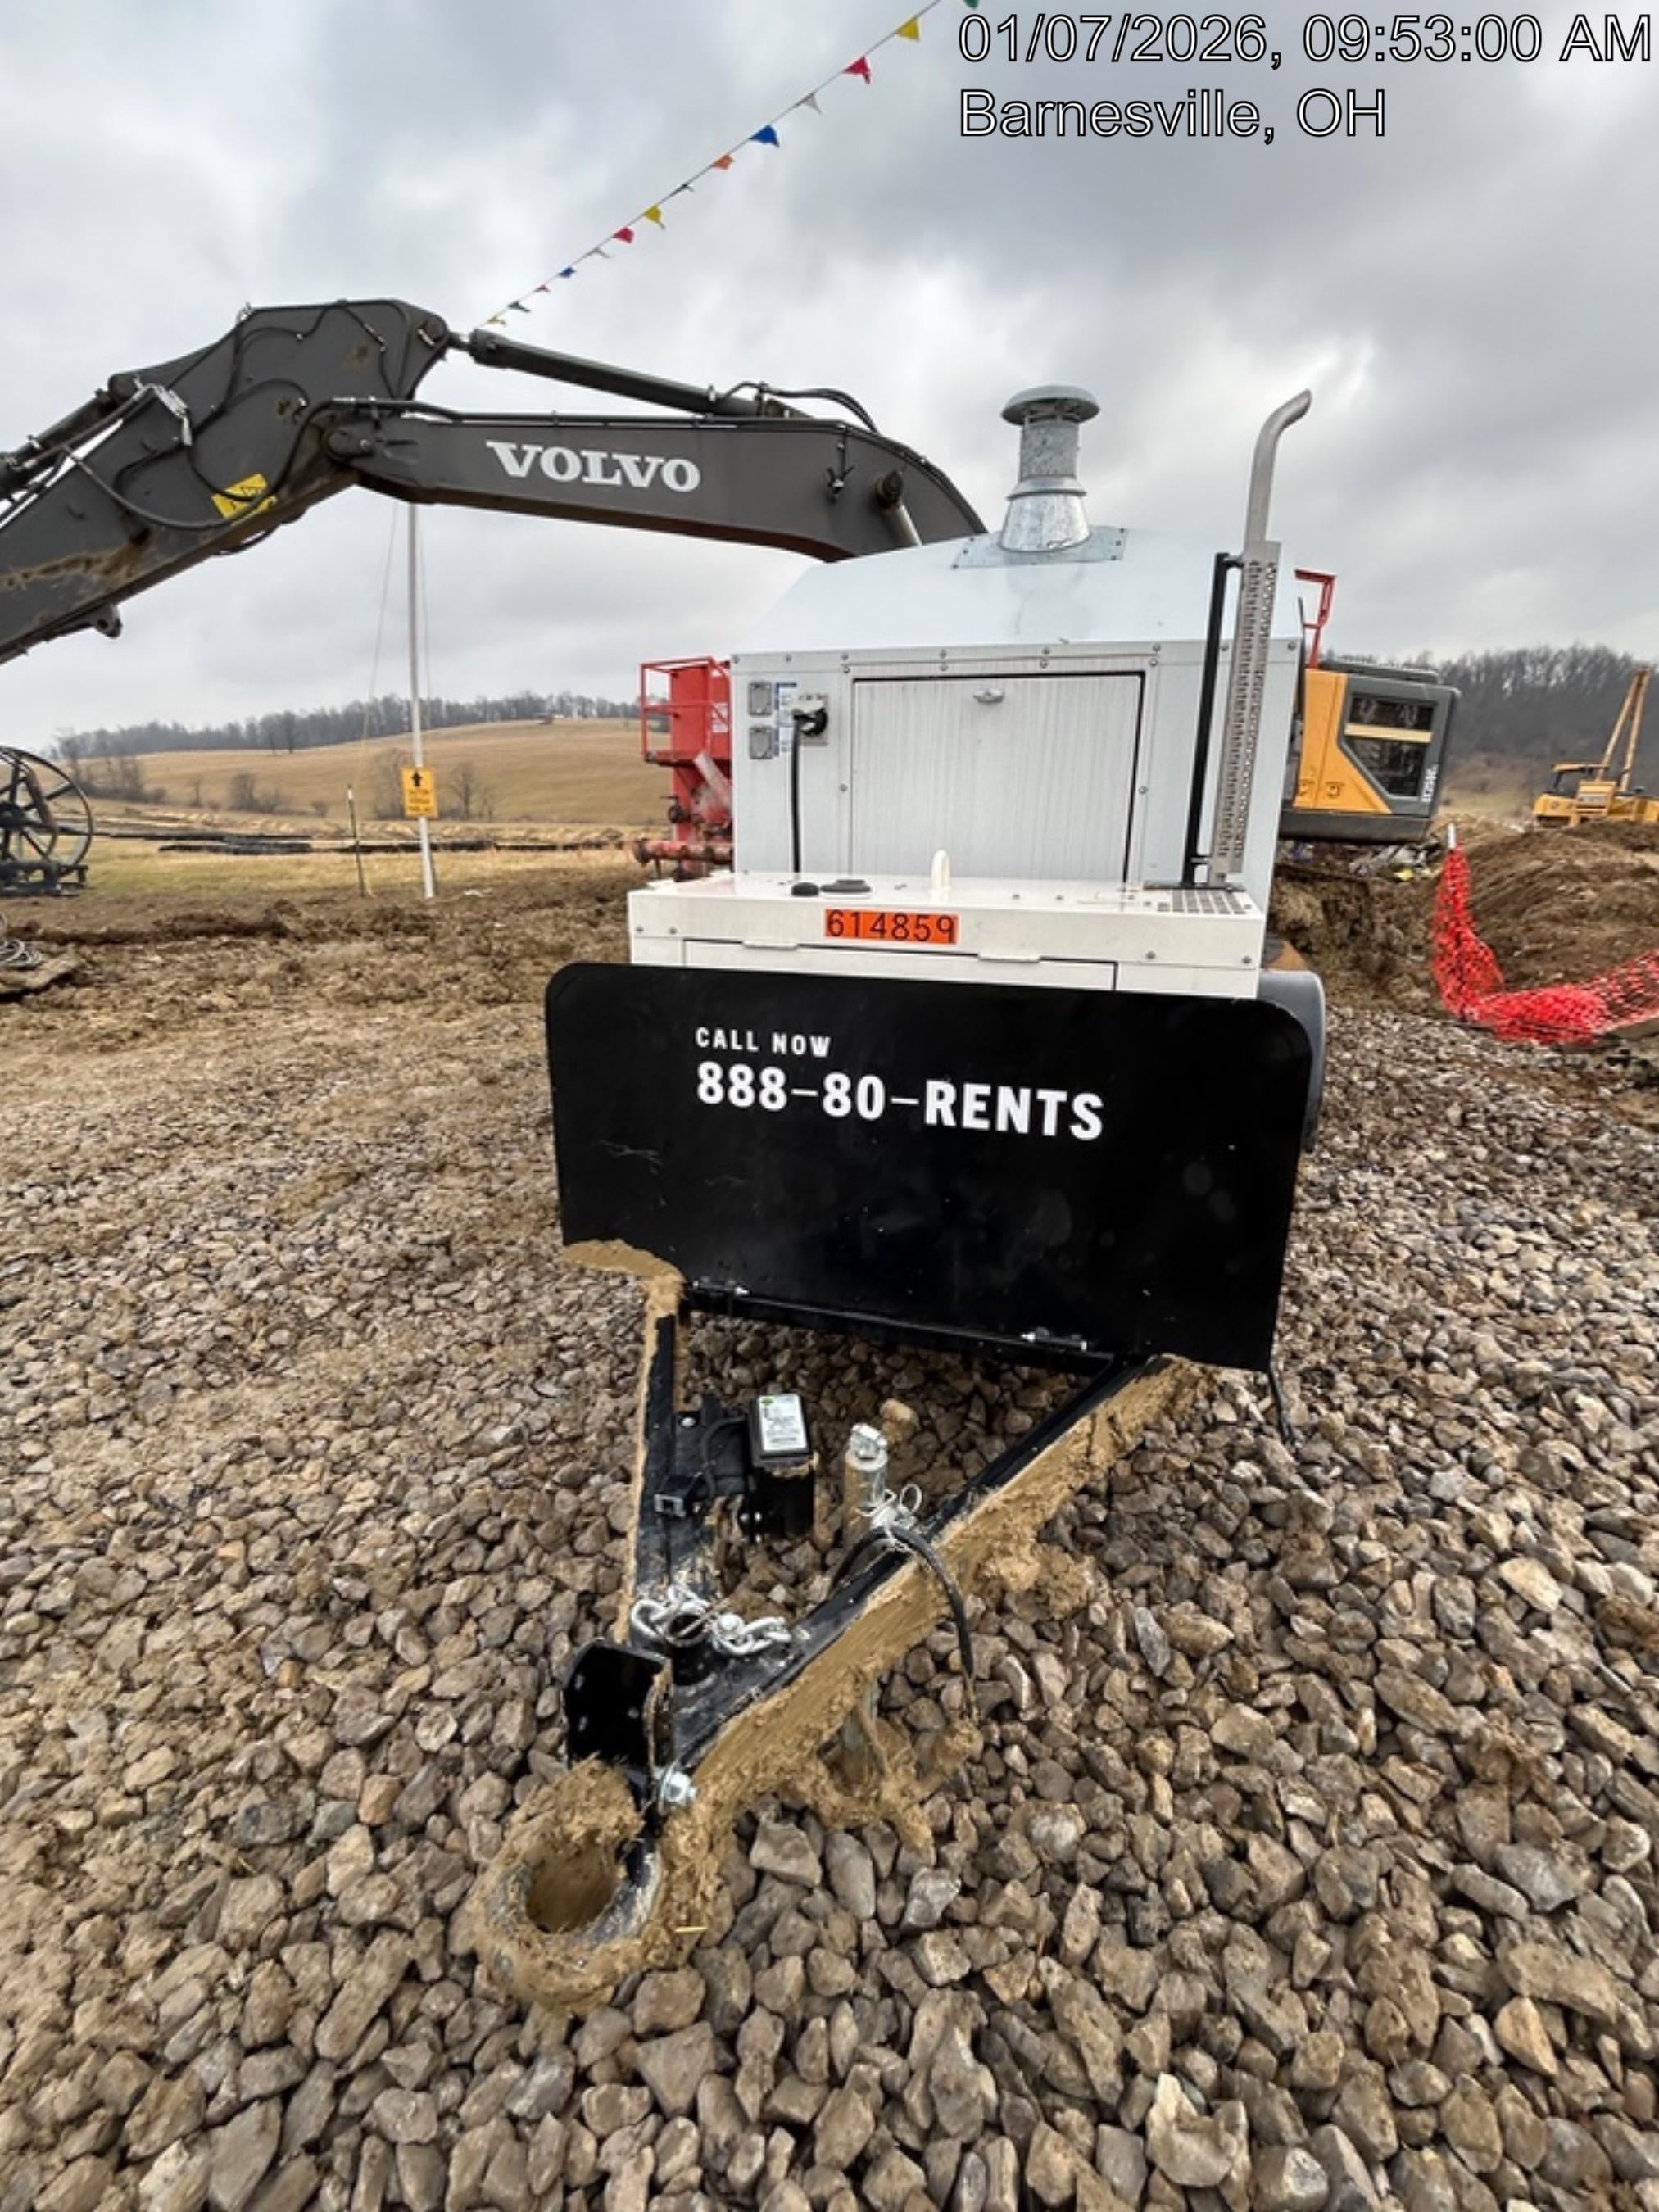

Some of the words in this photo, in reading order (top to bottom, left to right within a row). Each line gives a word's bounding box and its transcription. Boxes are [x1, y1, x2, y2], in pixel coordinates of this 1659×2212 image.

[485, 440, 701, 492] VOLVO
[827, 909, 955, 944] 614859
[695, 1027, 759, 1053] CALL
[772, 1032, 832, 1058] NOW
[696, 1061, 1104, 1141] 888-80-RENTS
